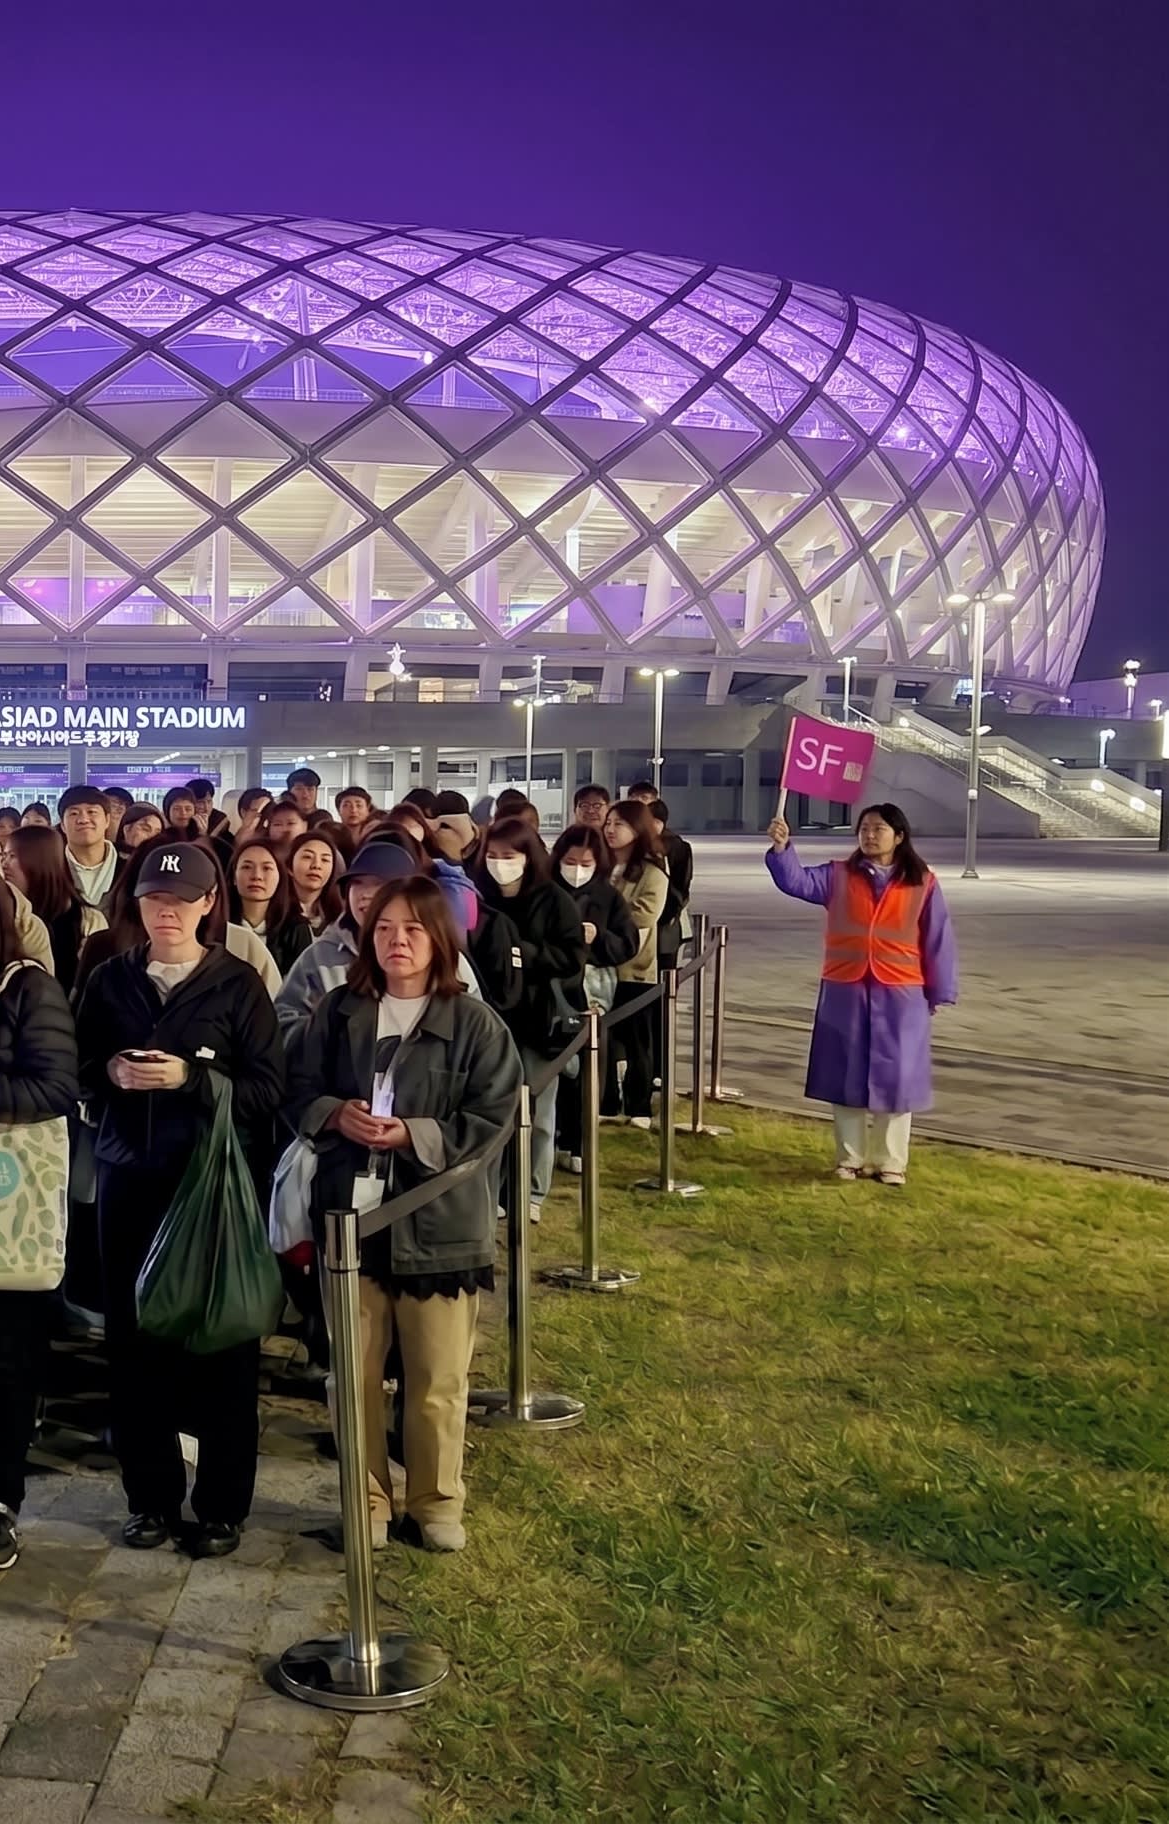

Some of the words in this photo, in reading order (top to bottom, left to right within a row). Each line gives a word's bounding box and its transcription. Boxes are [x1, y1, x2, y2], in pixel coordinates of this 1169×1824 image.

[64, 706, 129, 728] MAIN
[136, 706, 245, 729] STADIUM
[0, 729, 140, 748] 부산아시아드주경기장
[795, 737, 844, 776] SF
